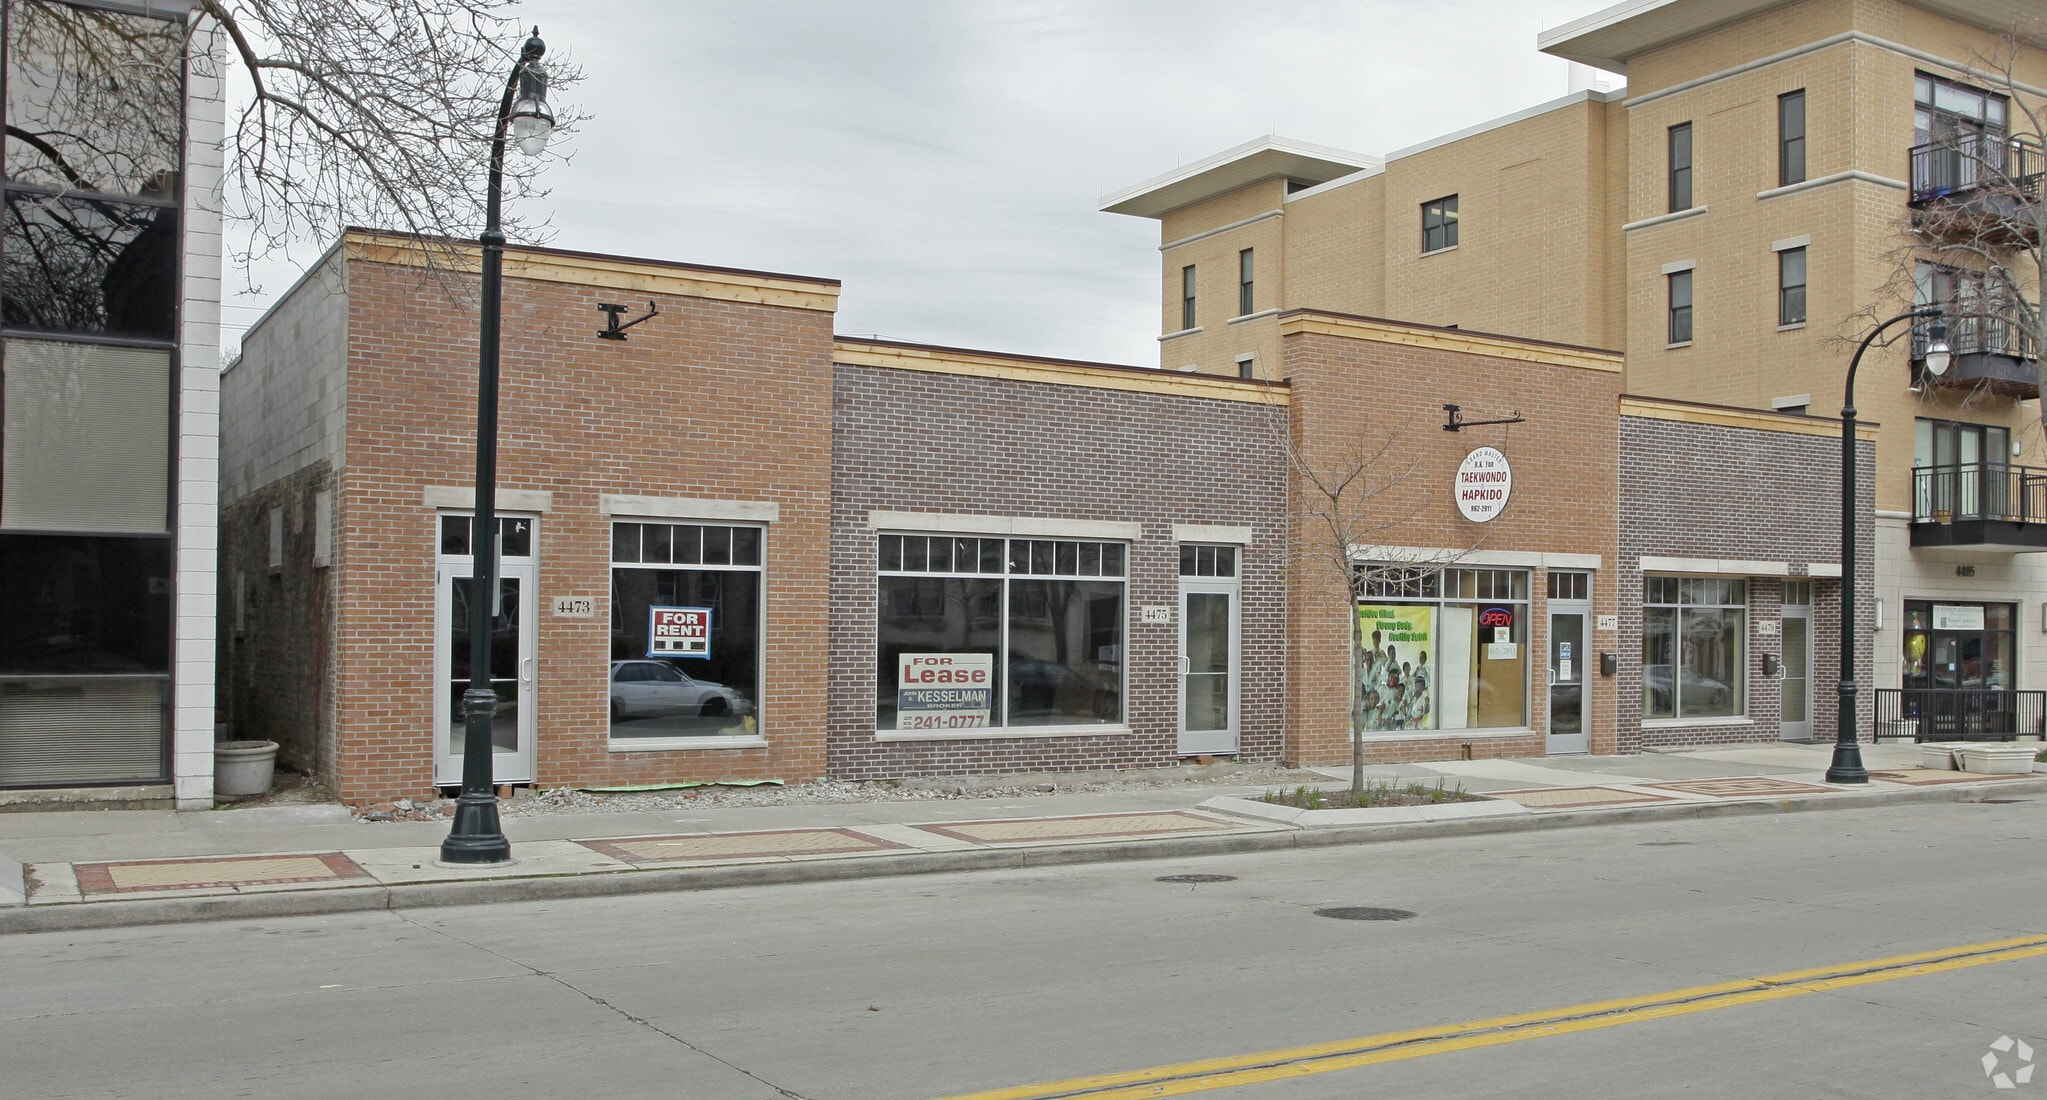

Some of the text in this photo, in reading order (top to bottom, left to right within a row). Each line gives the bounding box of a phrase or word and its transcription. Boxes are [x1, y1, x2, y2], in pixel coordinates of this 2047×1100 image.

[1461, 471, 1507, 483] TAEKWONDO
[1462, 489, 1503, 501] HAPKIDO
[557, 600, 591, 613] 4473
[662, 613, 699, 625] FOR
[1145, 609, 1168, 619] 4475
[1482, 613, 1513, 626] OPEN
[1600, 618, 1616, 627] 4477
[657, 625, 705, 636] RENT
[904, 665, 987, 684] Lease
[918, 690, 987, 703] KESSELMAN
[914, 715, 985, 729] 241-0777
